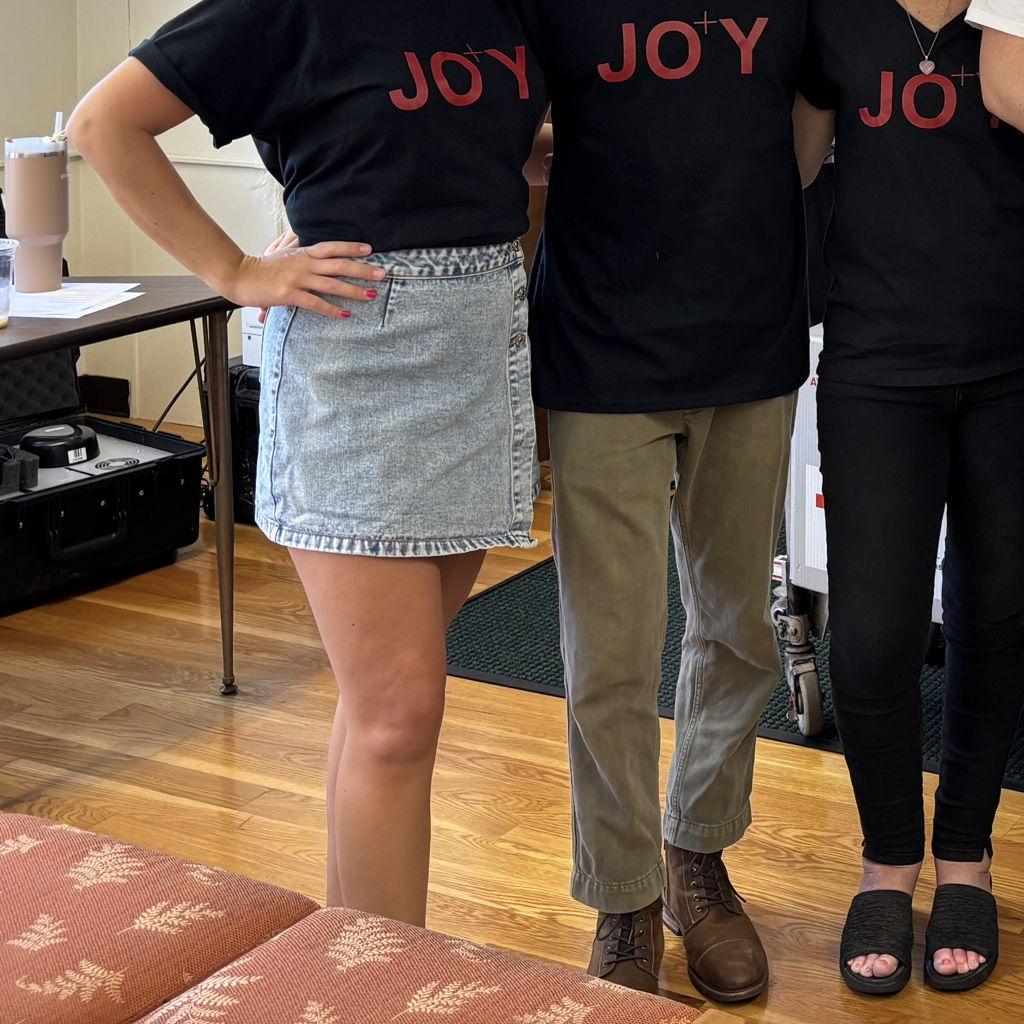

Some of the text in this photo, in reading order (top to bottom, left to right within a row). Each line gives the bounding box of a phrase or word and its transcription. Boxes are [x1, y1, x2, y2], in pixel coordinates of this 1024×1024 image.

[388, 45, 530, 111] JOY
[597, 17, 769, 83] JOY
[858, 70, 1000, 130] JO
